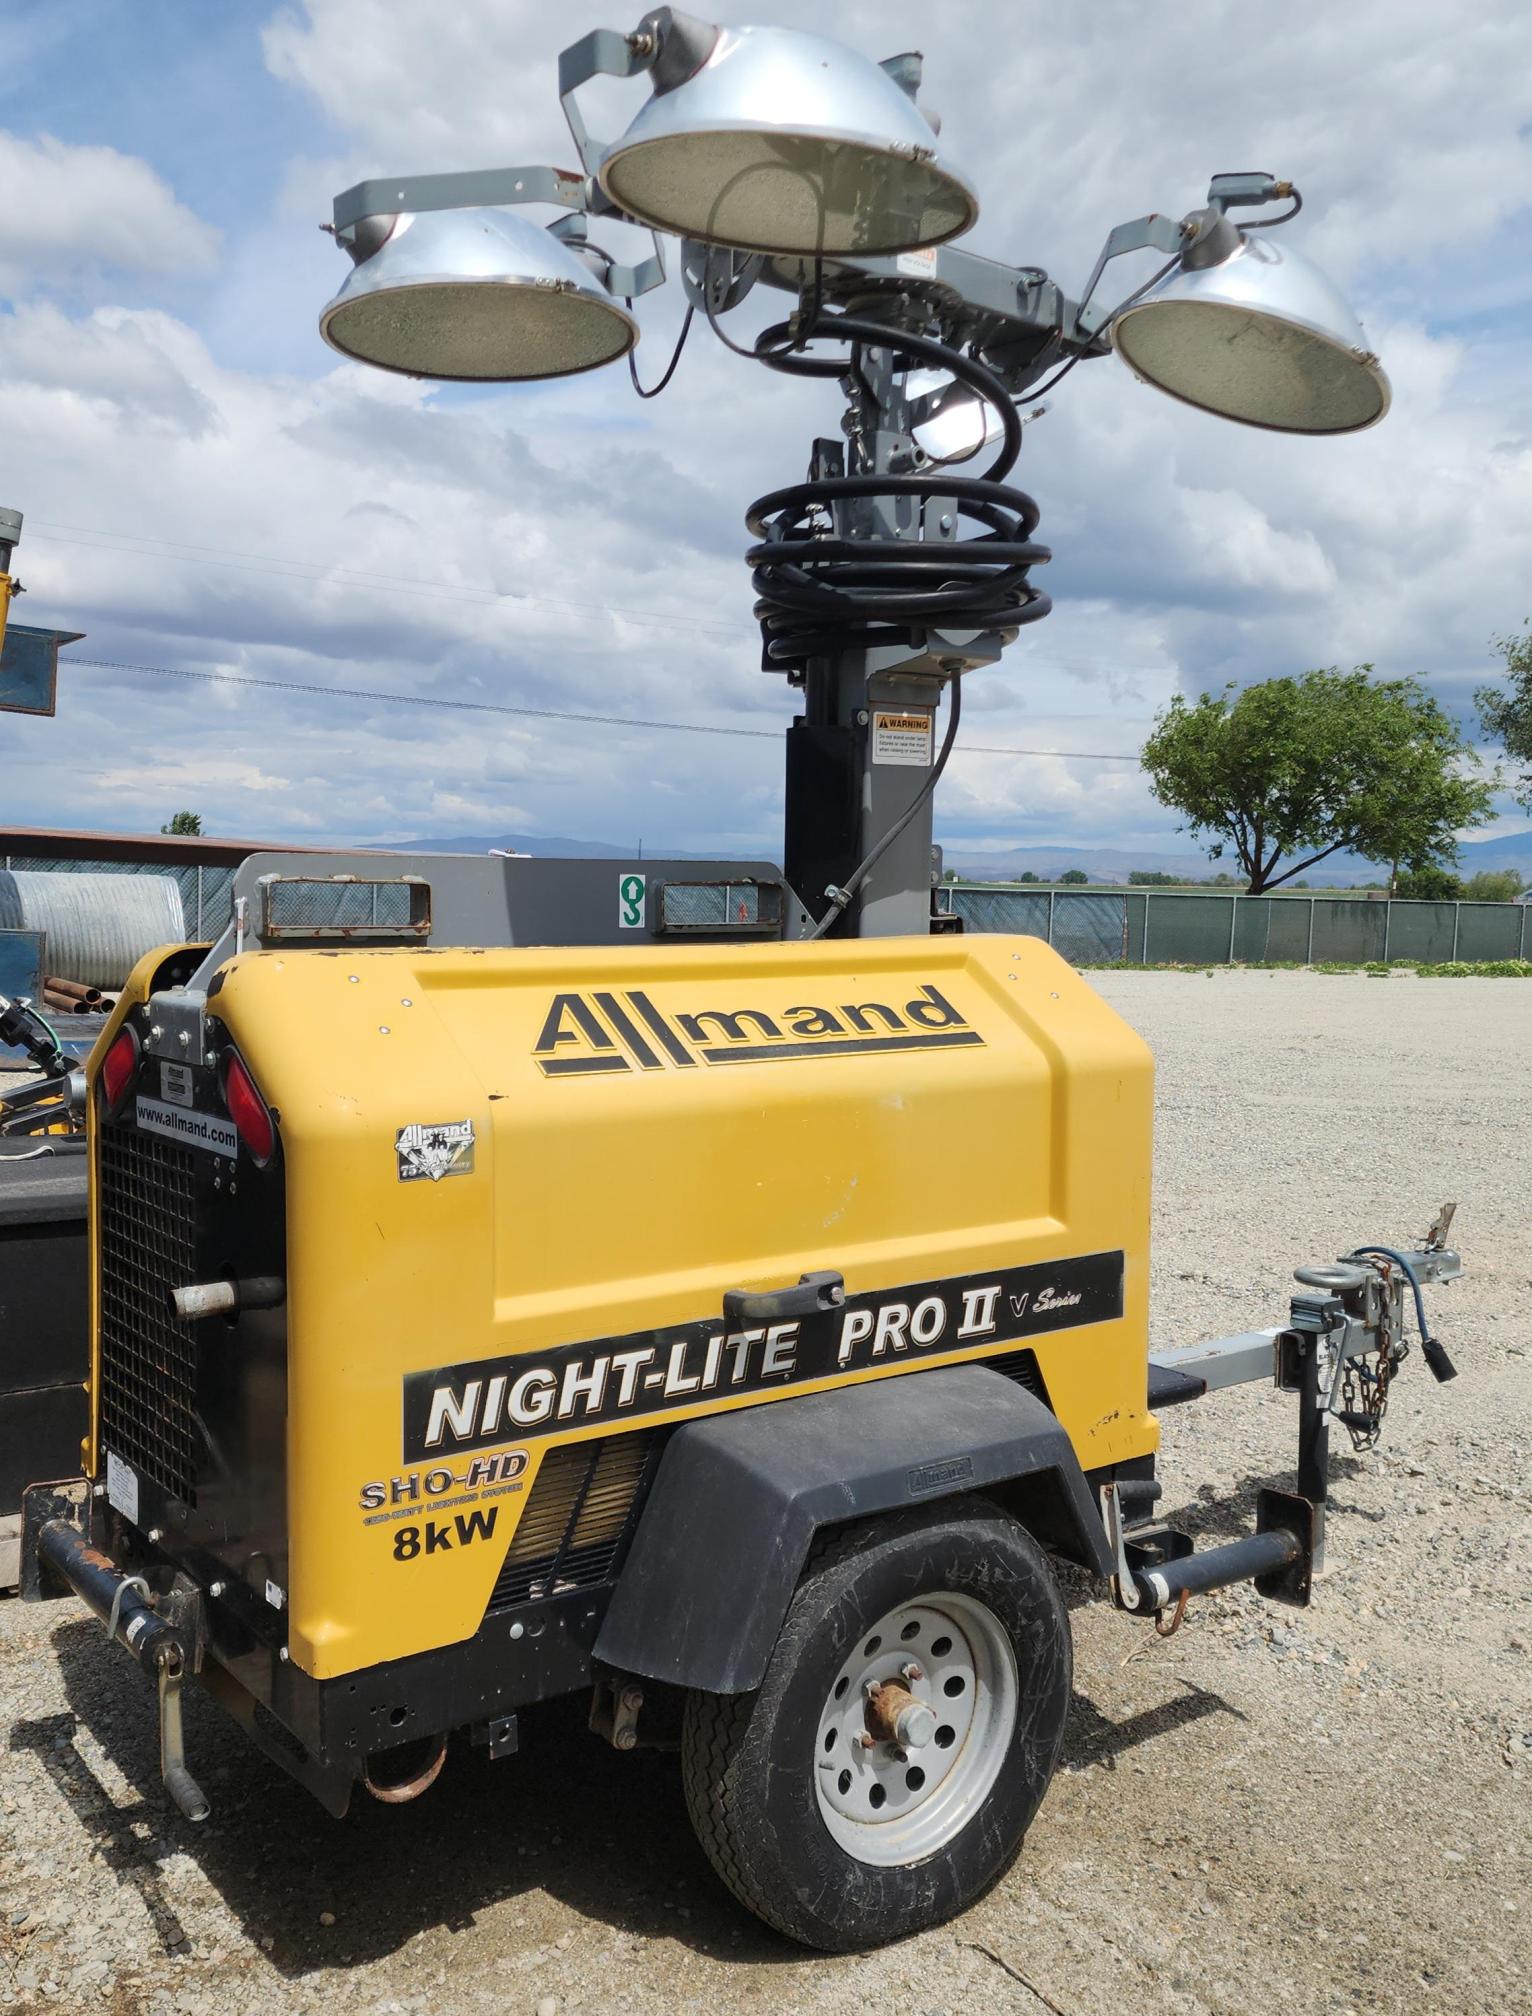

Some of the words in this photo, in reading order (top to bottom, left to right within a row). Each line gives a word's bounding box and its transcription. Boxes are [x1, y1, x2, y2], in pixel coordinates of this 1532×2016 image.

[889, 719, 928, 729] WARNING
[531, 984, 970, 1070] Allmand
[137, 1105, 236, 1148] www.allmand.com
[398, 1119, 472, 1149] Allmand
[424, 1322, 801, 1448] NIGHT-LITE
[837, 1296, 947, 1364] PRO
[957, 1286, 1002, 1339] II
[1009, 1292, 1029, 1318] V
[1032, 1287, 1082, 1313] Series
[358, 1448, 531, 1511] SHO-HD
[393, 1506, 499, 1562] 8kW
